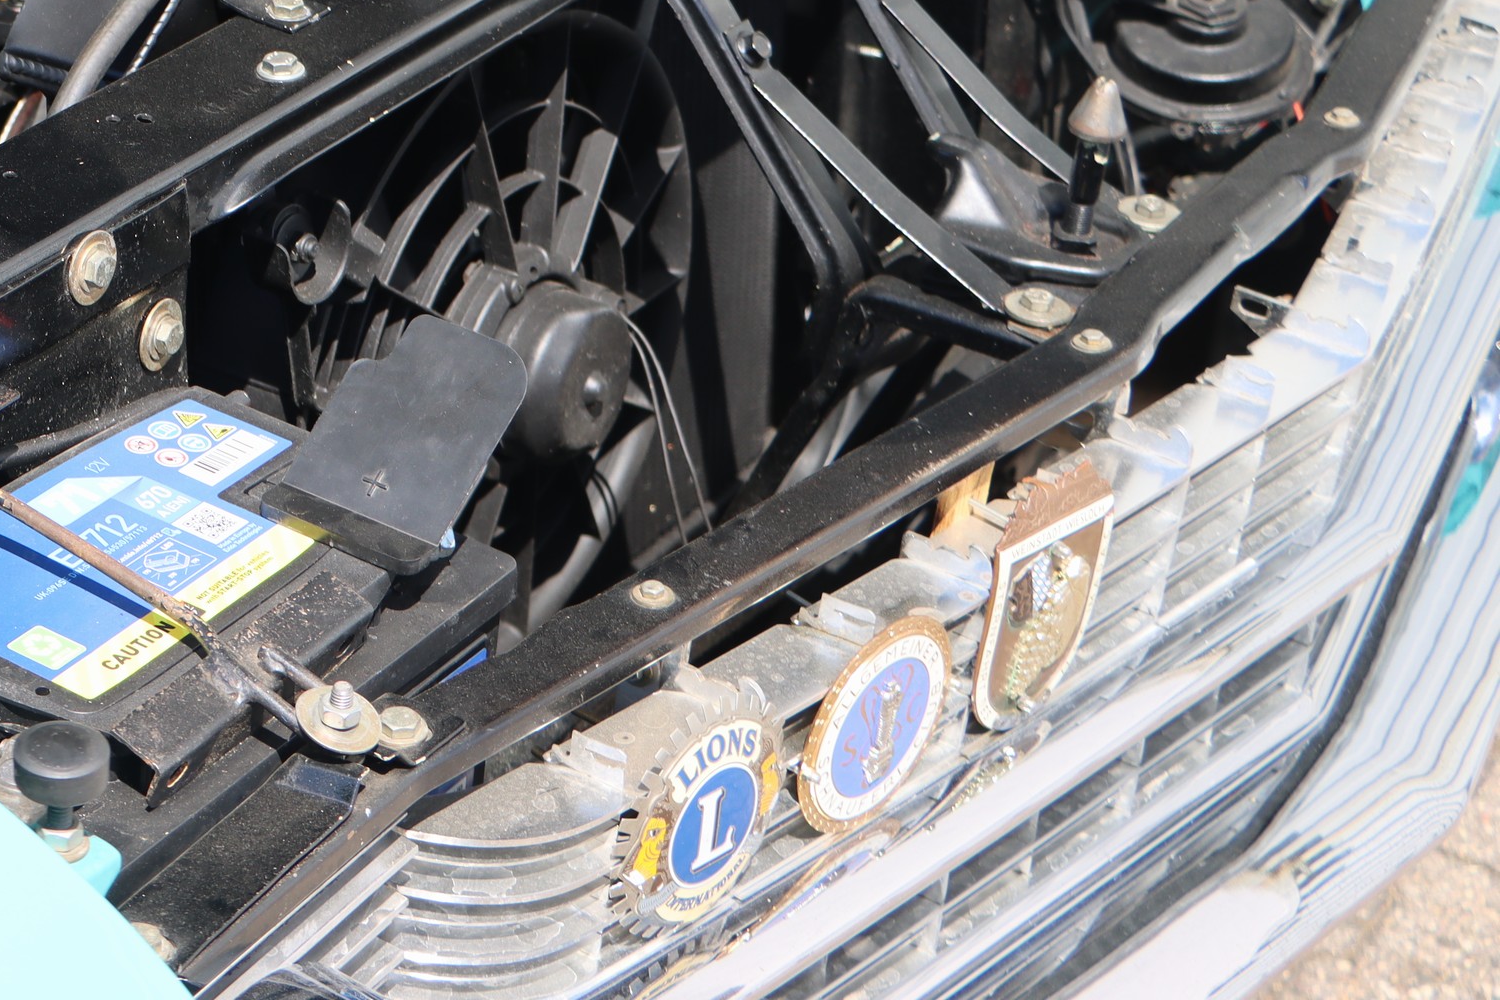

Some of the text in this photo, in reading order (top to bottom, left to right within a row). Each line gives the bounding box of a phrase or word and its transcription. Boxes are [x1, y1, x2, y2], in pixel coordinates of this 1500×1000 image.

[84, 457, 110, 474] 12V
[135, 485, 172, 510] 670
[47, 513, 139, 568] E712
[101, 620, 176, 671] CAUTION
[676, 727, 757, 789] LIONS
[691, 785, 736, 874] L
